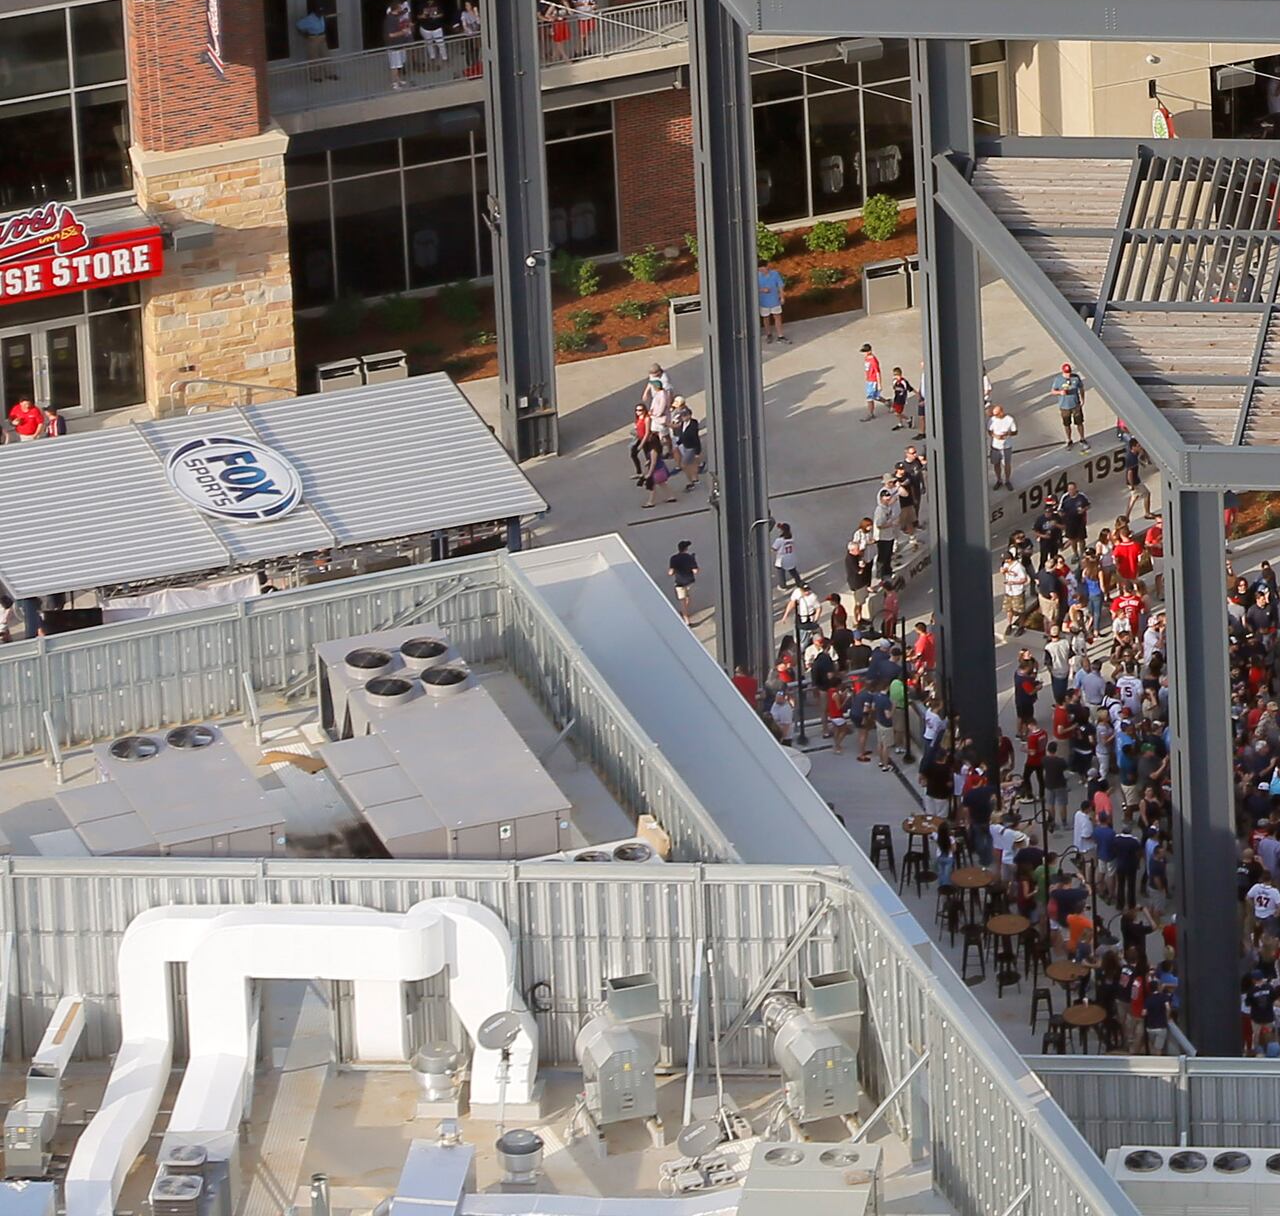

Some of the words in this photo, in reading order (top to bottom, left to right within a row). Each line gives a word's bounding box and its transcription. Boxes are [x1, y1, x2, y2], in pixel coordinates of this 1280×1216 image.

[0, 264, 41, 297] SE
[51, 244, 150, 287] STORE
[184, 457, 235, 508] SPORTS
[204, 450, 284, 504] FOX
[1018, 471, 1069, 515] 1914
[1083, 448, 1128, 484] 195
